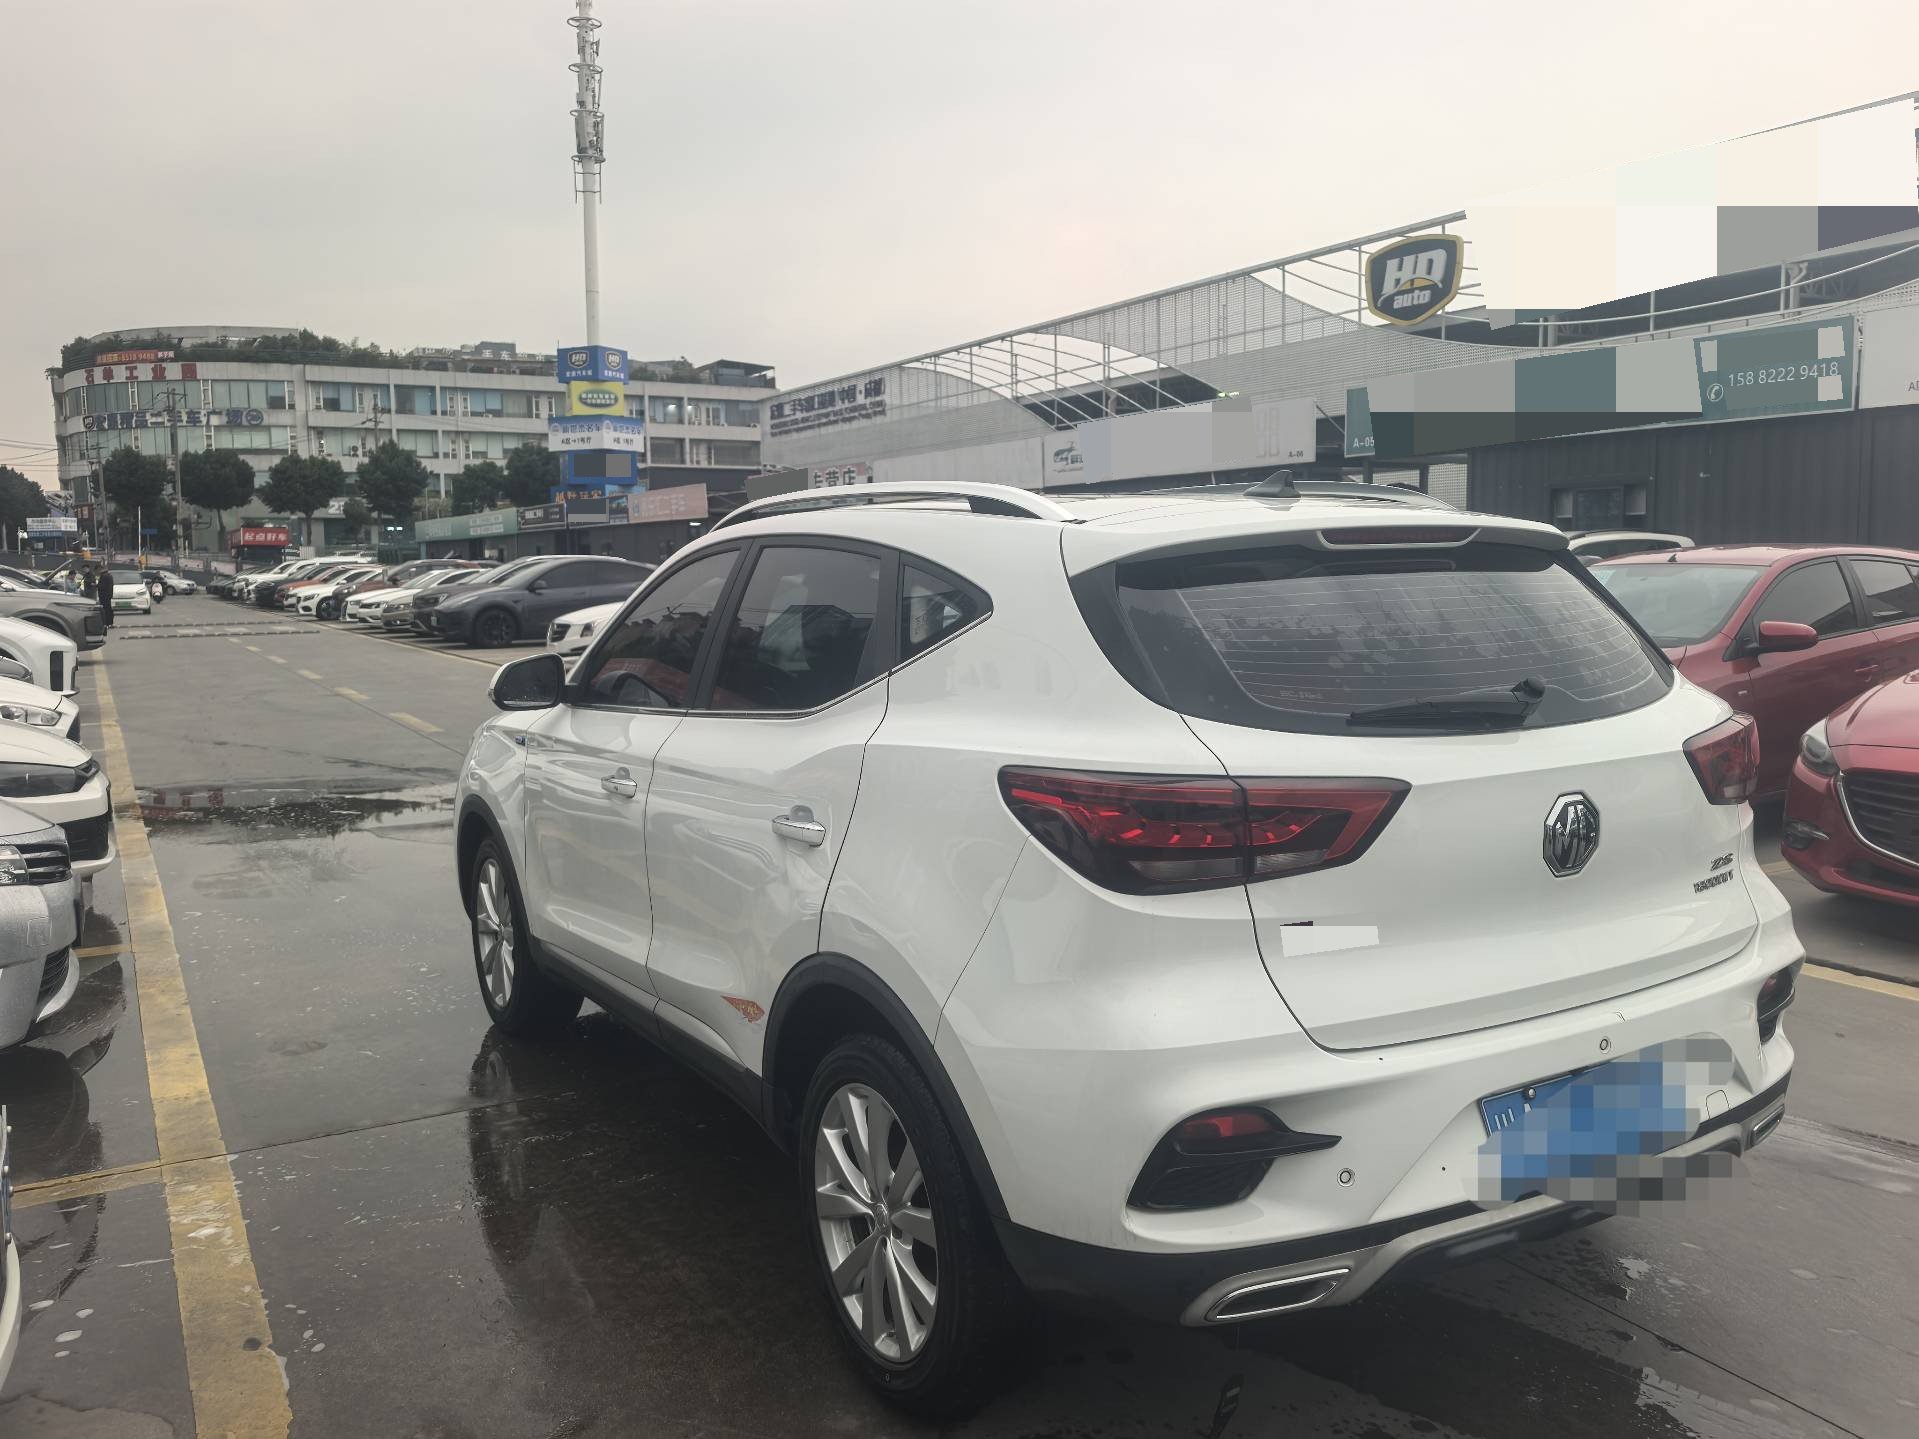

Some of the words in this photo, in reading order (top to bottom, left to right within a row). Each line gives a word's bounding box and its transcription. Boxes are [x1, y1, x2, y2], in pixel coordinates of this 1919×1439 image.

[1381, 249, 1447, 295] HD
[1393, 290, 1432, 309] auto
[1728, 371, 1754, 387] 158
[1758, 366, 1795, 384] 8222
[1800, 361, 1840, 381] 9418
